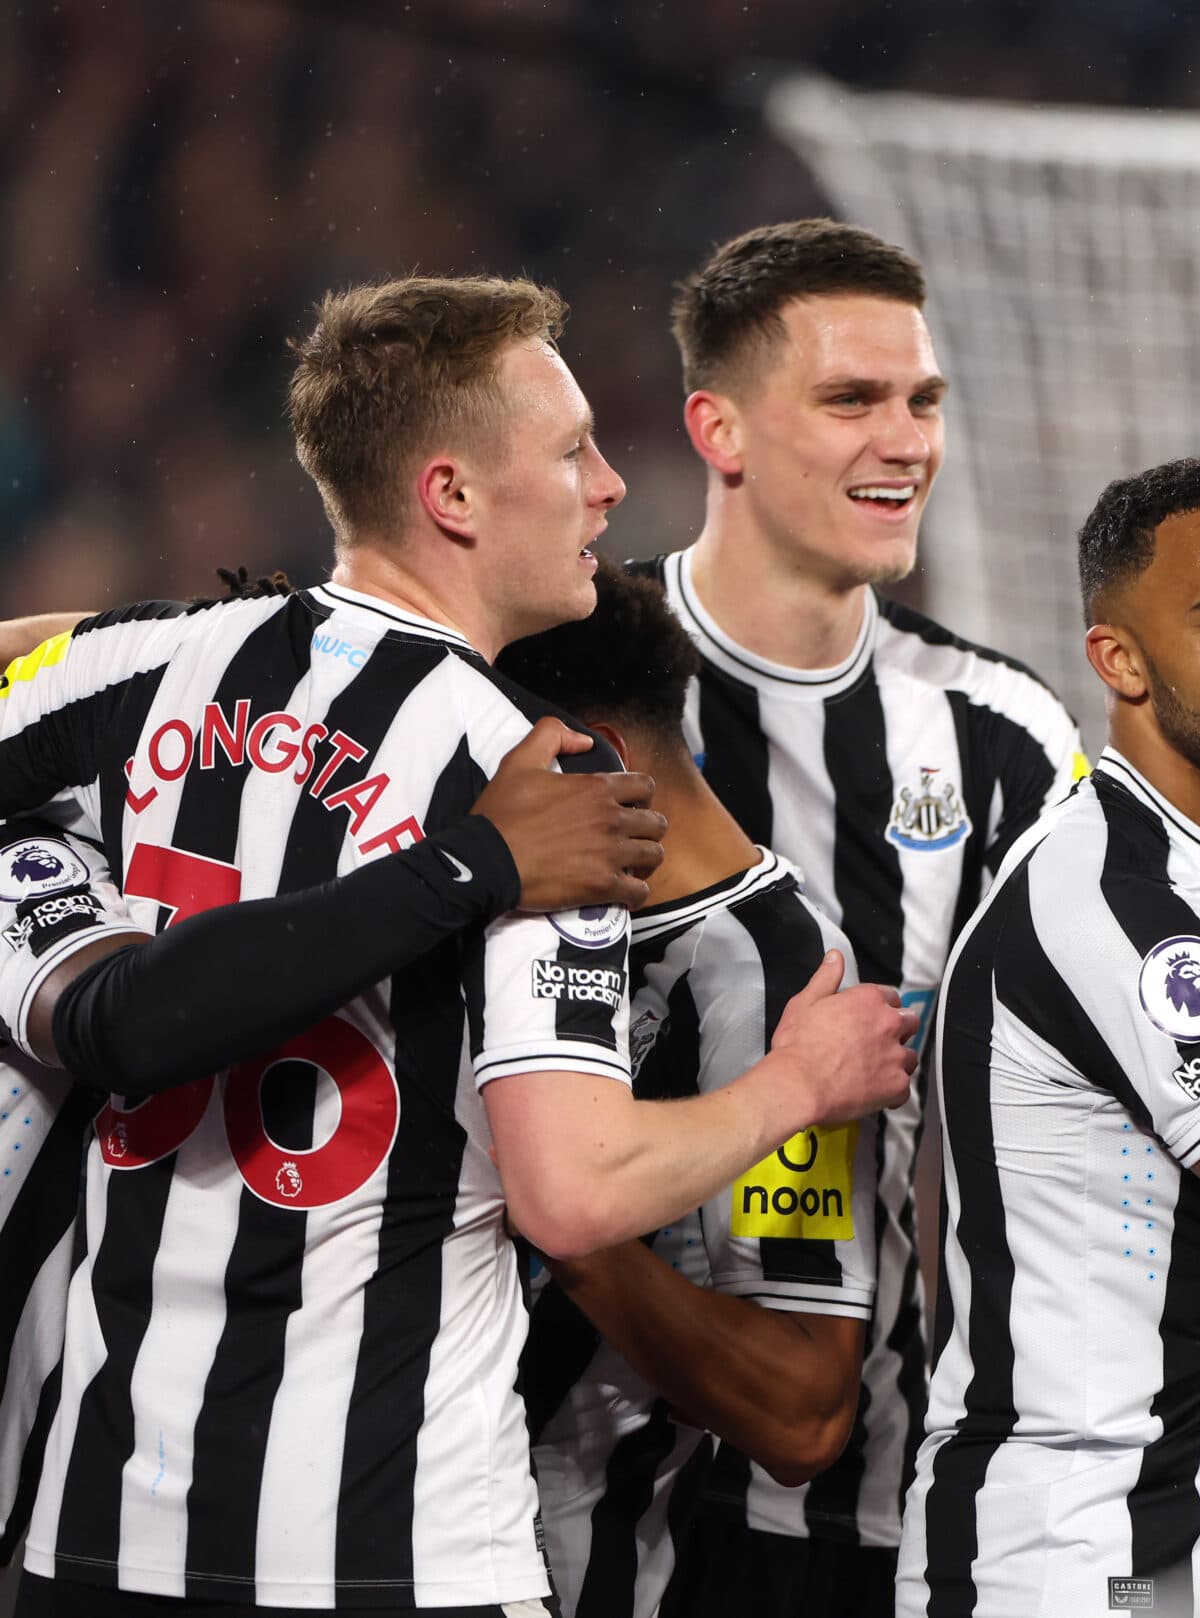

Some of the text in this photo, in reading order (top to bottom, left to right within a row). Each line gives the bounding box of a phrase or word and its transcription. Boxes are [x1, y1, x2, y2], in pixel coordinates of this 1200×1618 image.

[312, 633, 367, 669] NUFC
[33, 894, 94, 917] room
[532, 959, 621, 991] No room
[532, 979, 623, 1011] for racism
[742, 1185, 844, 1217] noon
